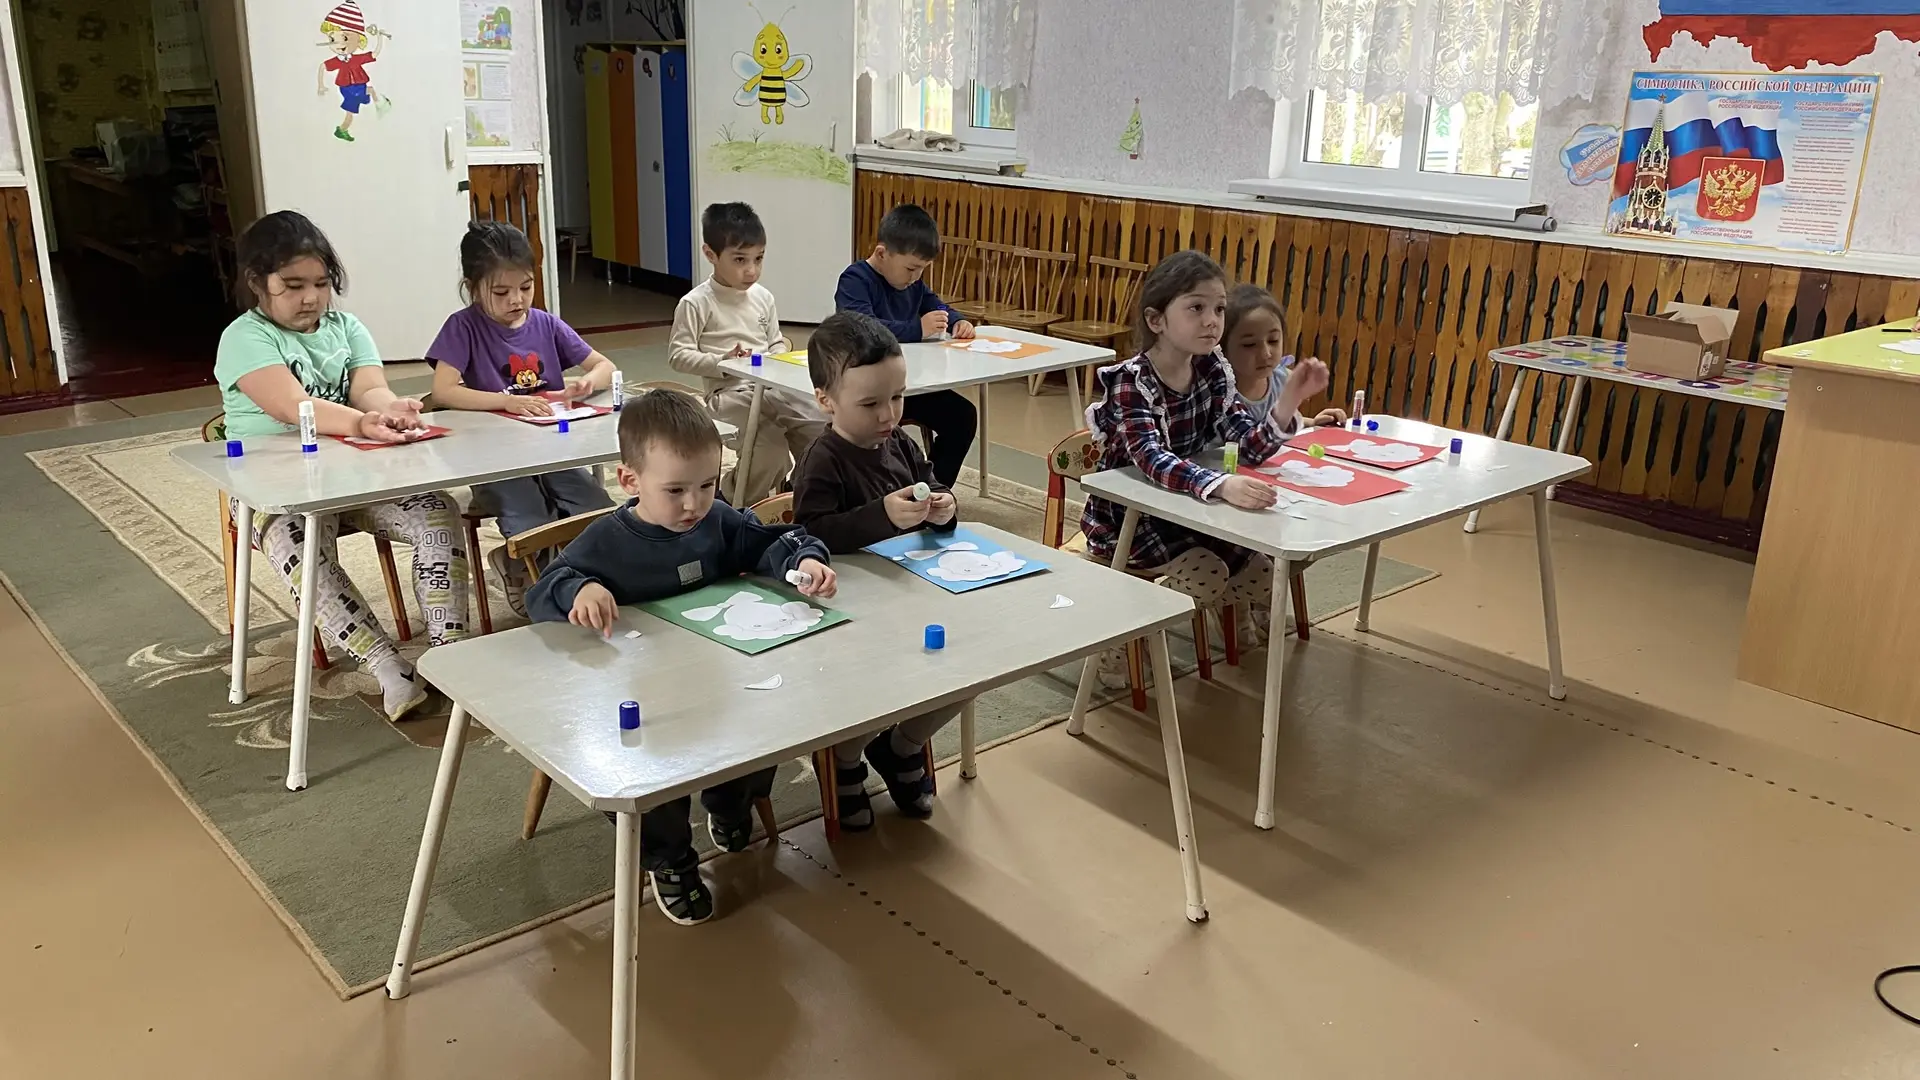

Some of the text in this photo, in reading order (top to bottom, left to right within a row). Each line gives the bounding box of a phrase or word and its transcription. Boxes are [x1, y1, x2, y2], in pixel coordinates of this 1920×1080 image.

[1636, 78, 1872, 95] СИМВОЛИКА РОССИЙСКОЙ ФЕДЕРАЦИИ
[422, 529, 451, 548] 00
[429, 578, 450, 590] 99
